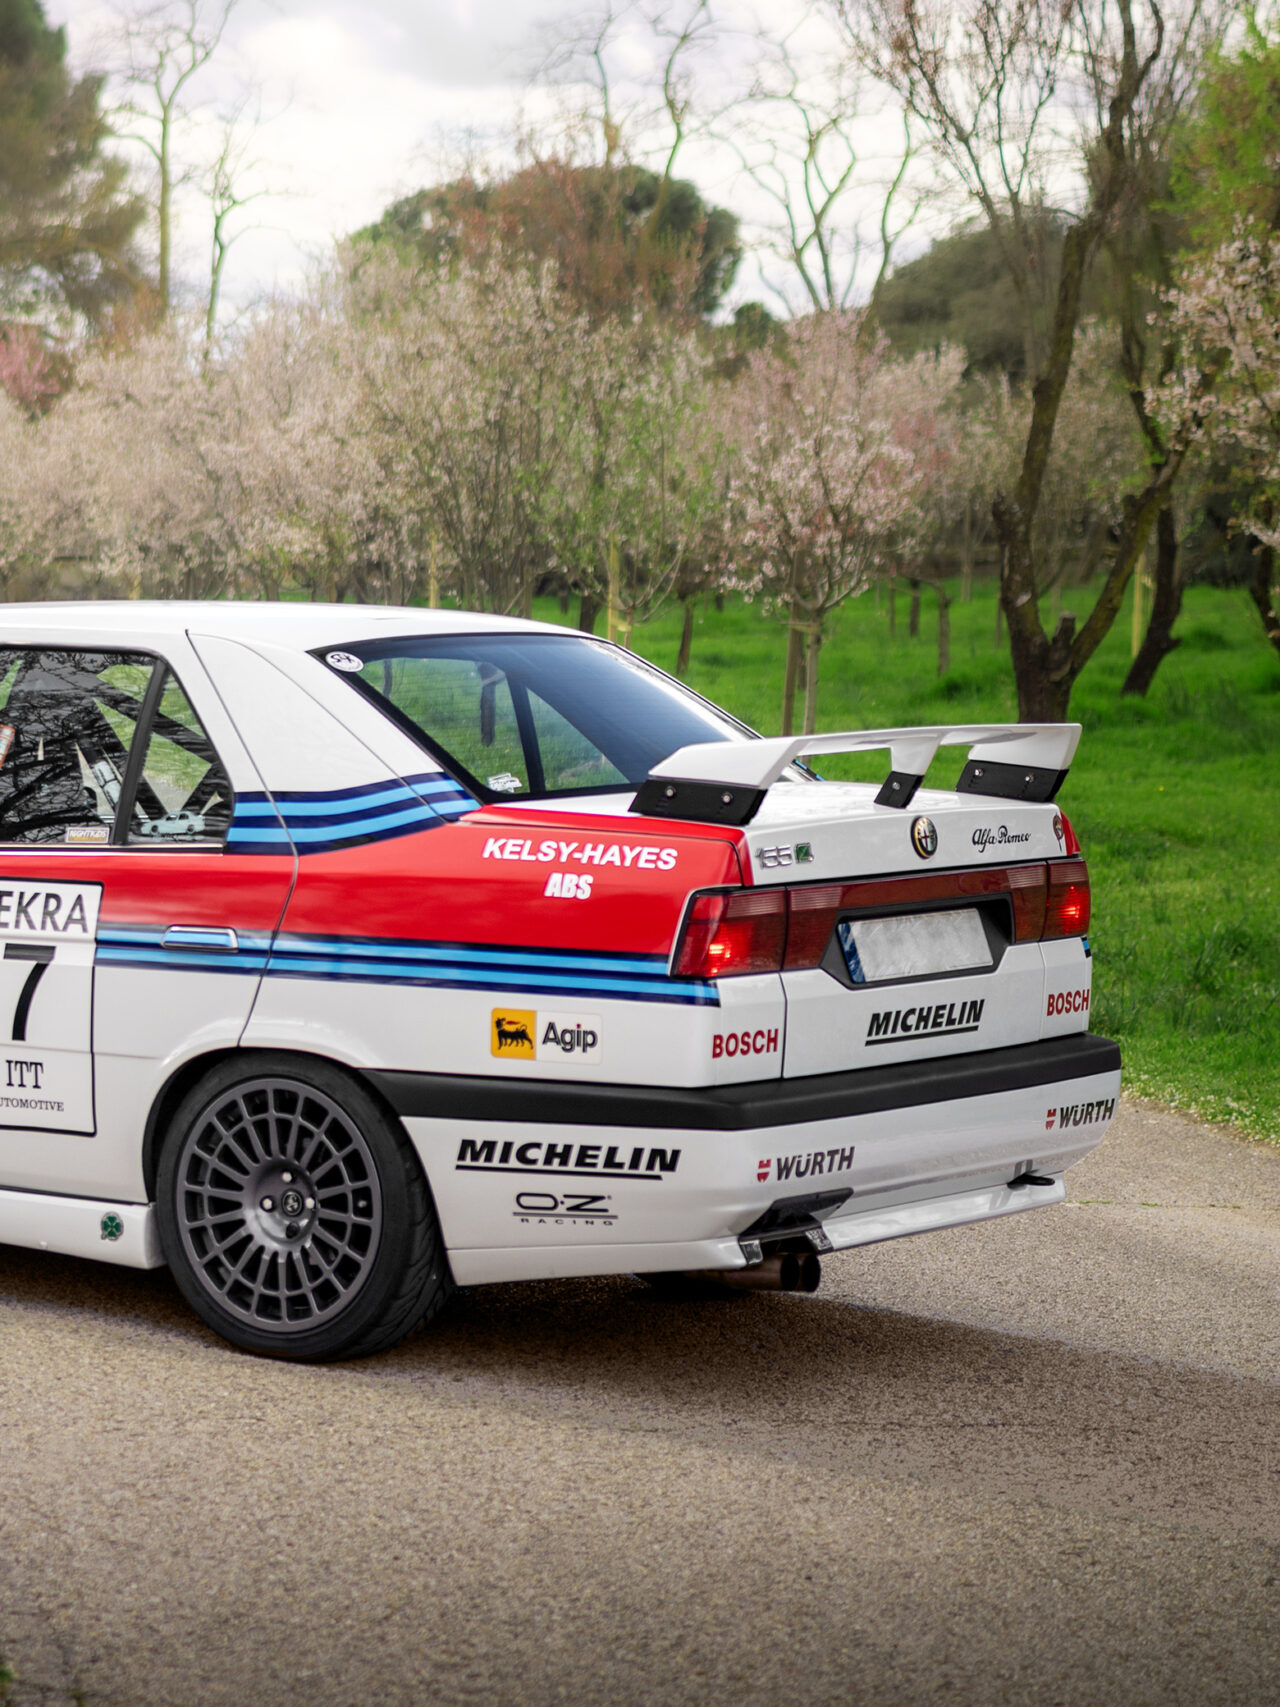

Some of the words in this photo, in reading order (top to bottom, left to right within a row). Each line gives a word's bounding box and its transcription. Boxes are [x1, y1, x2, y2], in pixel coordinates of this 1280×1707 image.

[482, 838, 678, 870] KELSY-HAYES
[972, 828, 996, 853] Alfa
[755, 845, 792, 869] 155
[544, 872, 594, 900] ABS
[3, 943, 56, 1041] 7
[1046, 989, 1090, 1016] BOSCH
[867, 999, 985, 1037] MICHELIN
[542, 1022, 598, 1052] Agip
[712, 1028, 779, 1058] BOSCH
[5, 1059, 44, 1089] ITT
[1059, 1098, 1115, 1129] WÜRTH
[456, 1139, 681, 1172] MICHELIN
[777, 1146, 855, 1181] WÜRTH
[521, 1218, 613, 1226] RACING
